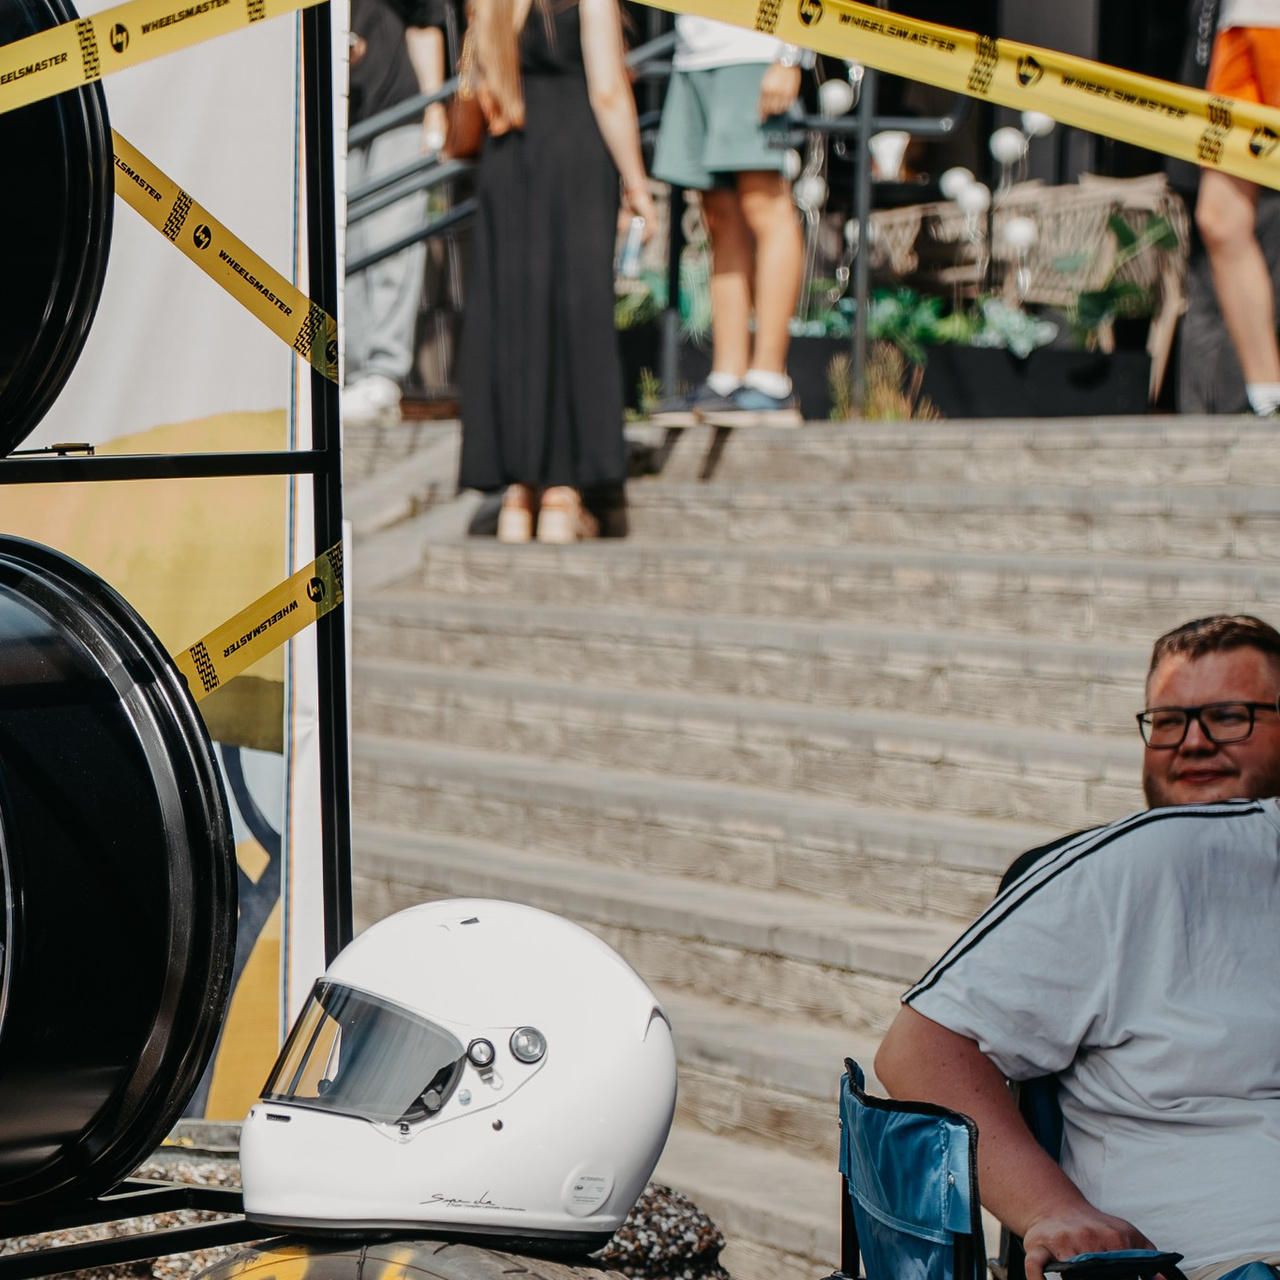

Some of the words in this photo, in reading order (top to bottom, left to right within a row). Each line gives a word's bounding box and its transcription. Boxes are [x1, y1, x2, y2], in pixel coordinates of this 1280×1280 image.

[838, 12, 957, 54] WHEELSMASTER
[218, 249, 293, 317] WHEELSMASTER
[223, 600, 298, 658] WHEELSMASTER
